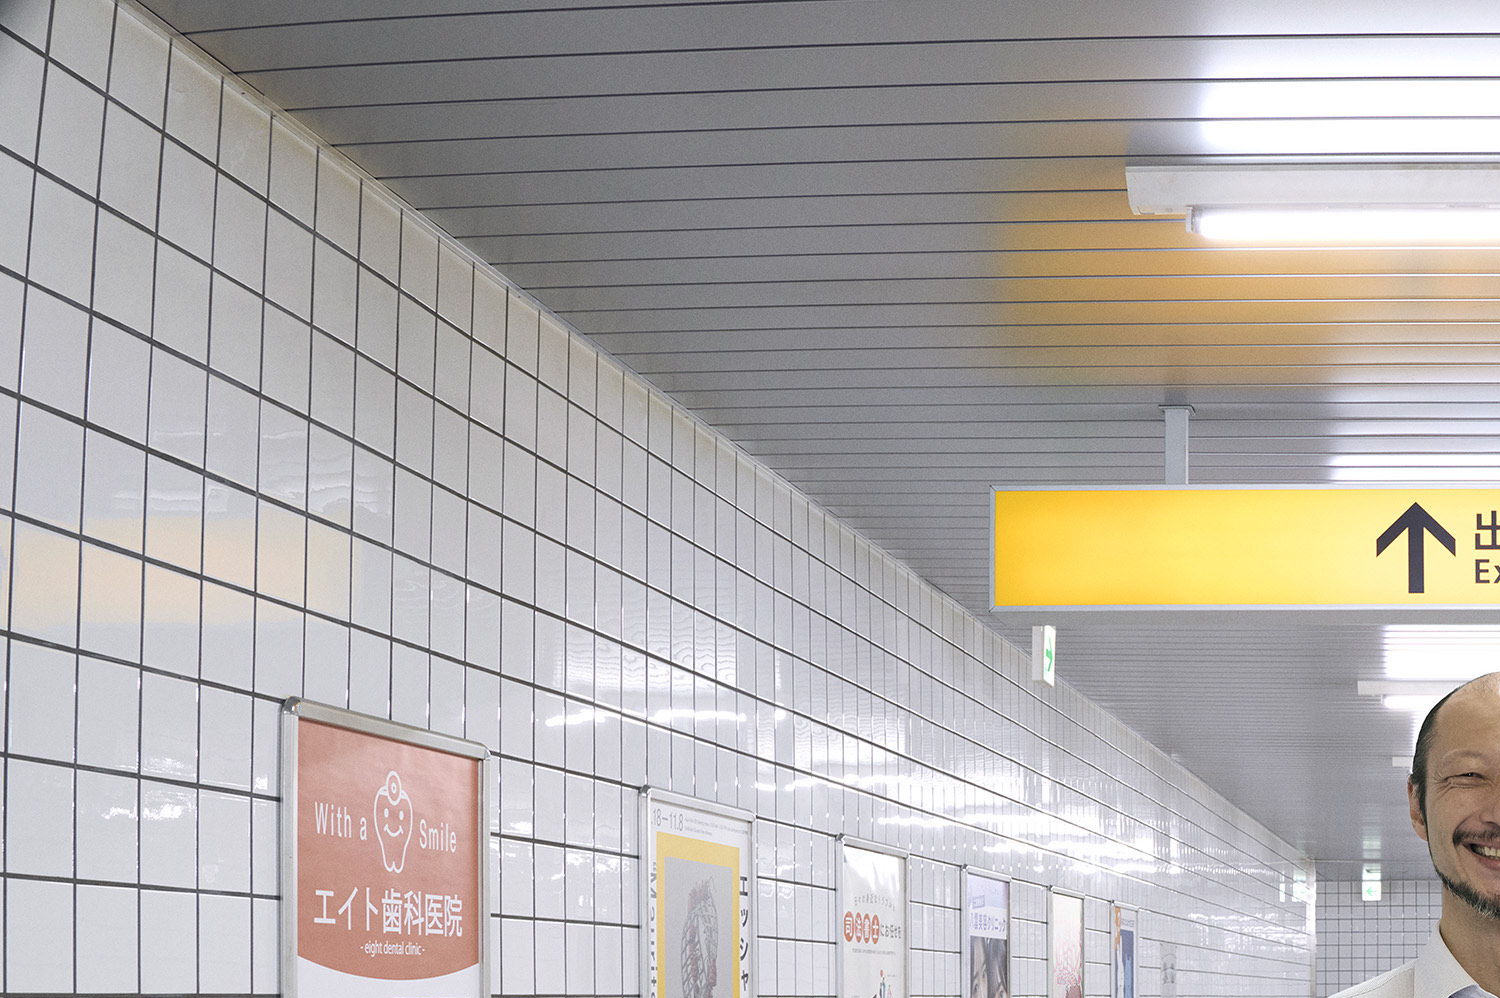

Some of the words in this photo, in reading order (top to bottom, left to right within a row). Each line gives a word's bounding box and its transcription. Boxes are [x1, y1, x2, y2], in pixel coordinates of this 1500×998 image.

[314, 801, 352, 839] With
[359, 816, 368, 841] a
[419, 819, 457, 853] Smile
[313, 886, 463, 937] エイト歯科医院
[383, 941, 404, 955] dental
[405, 942, 422, 956] clinic
